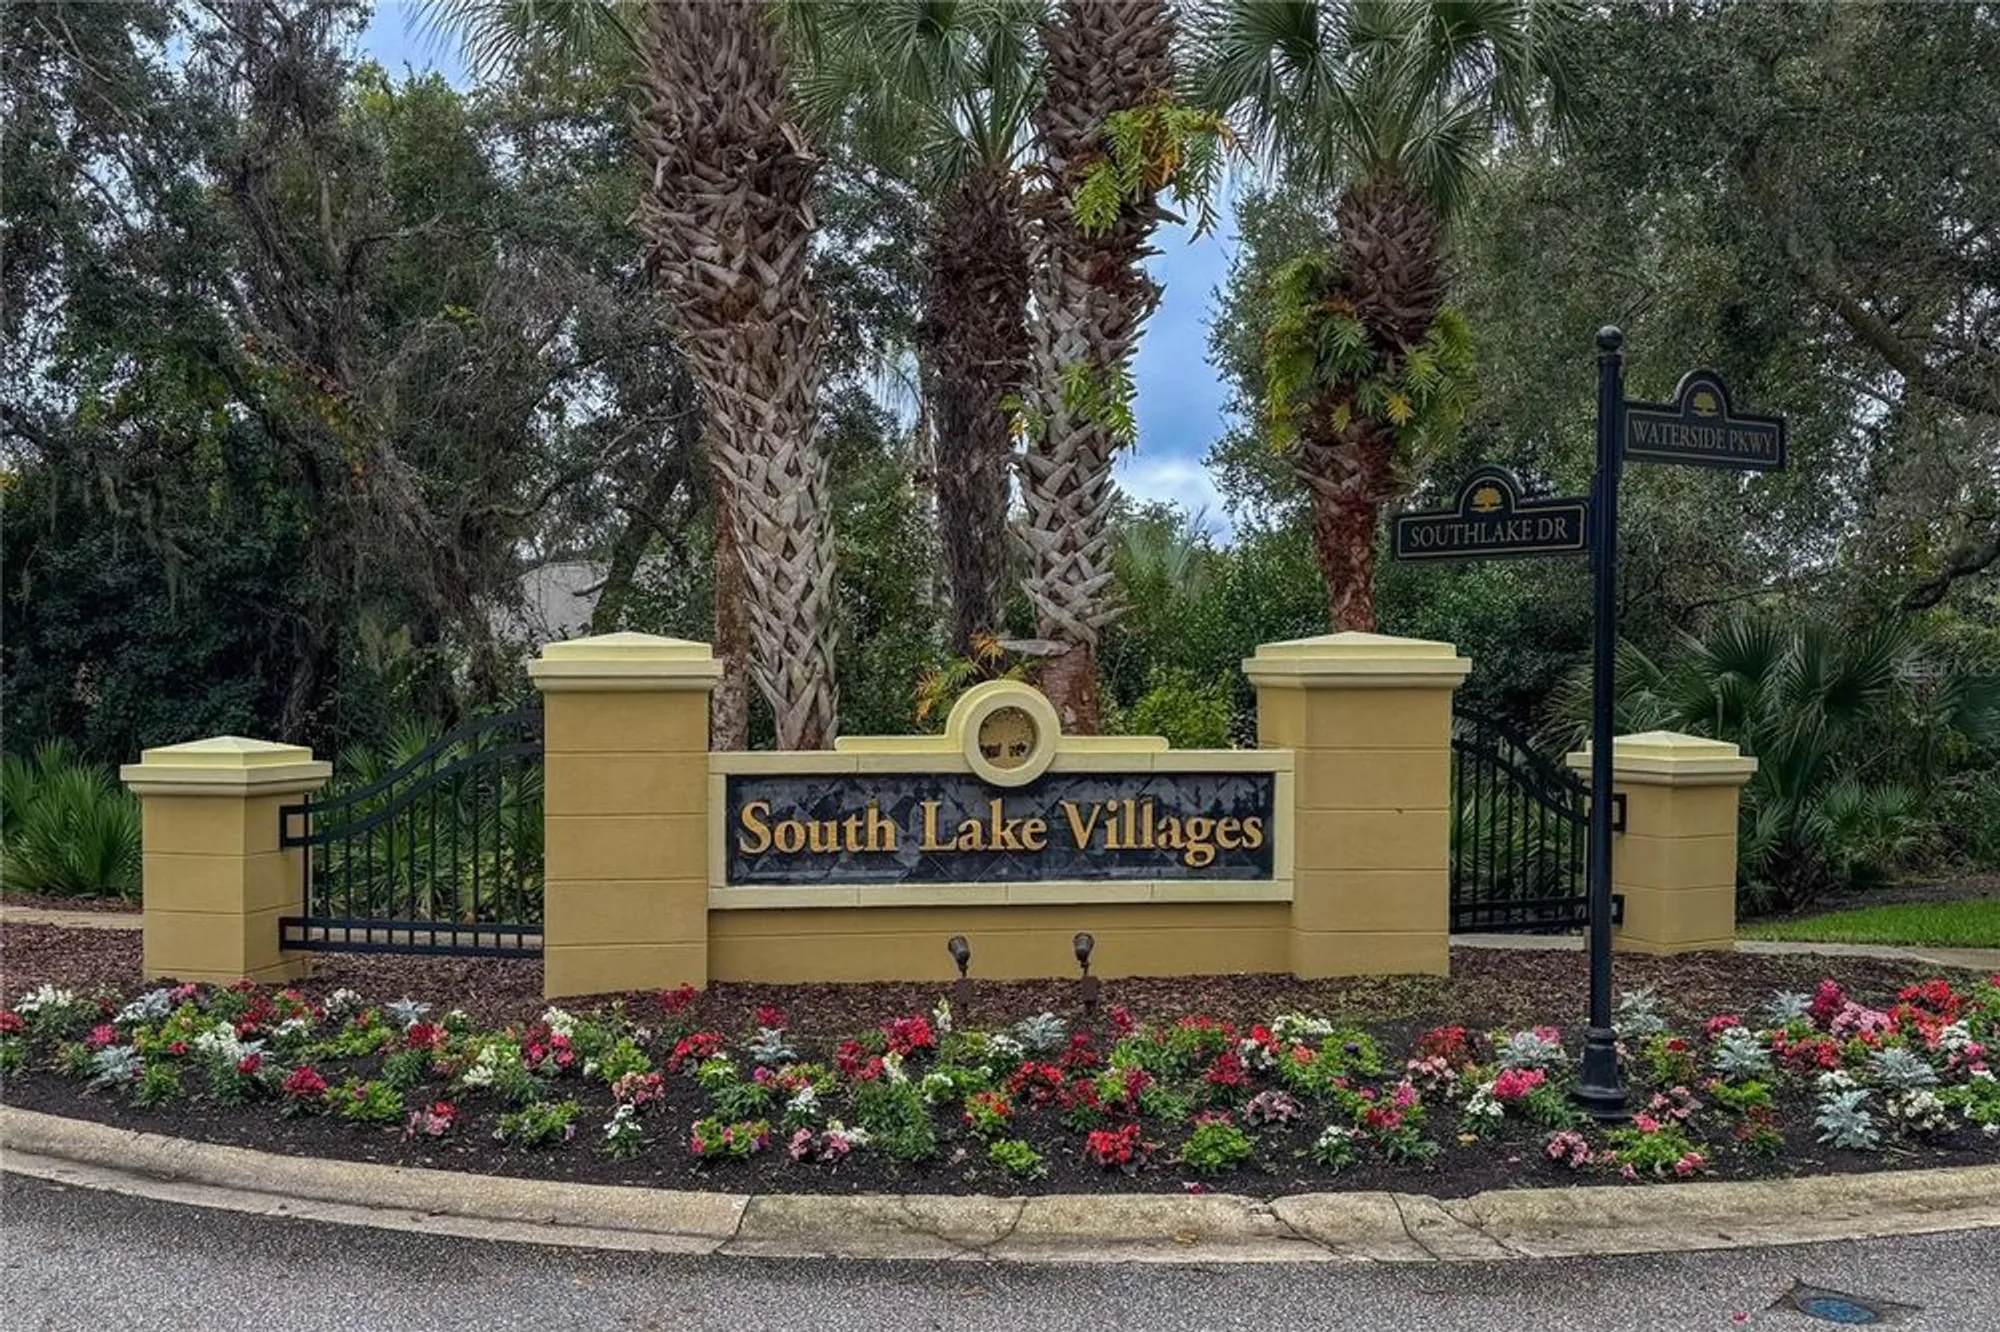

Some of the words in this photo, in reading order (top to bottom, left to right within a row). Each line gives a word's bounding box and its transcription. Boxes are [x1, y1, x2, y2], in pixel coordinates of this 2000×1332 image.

[1631, 419, 1727, 449] WATERSIDE
[1729, 430, 1774, 454] PKWY
[1410, 519, 1534, 547] SOUTHLAKE
[1537, 517, 1569, 540] DR
[738, 798, 899, 854] South
[920, 797, 1048, 852] Lake
[1058, 796, 1264, 867] Villages
